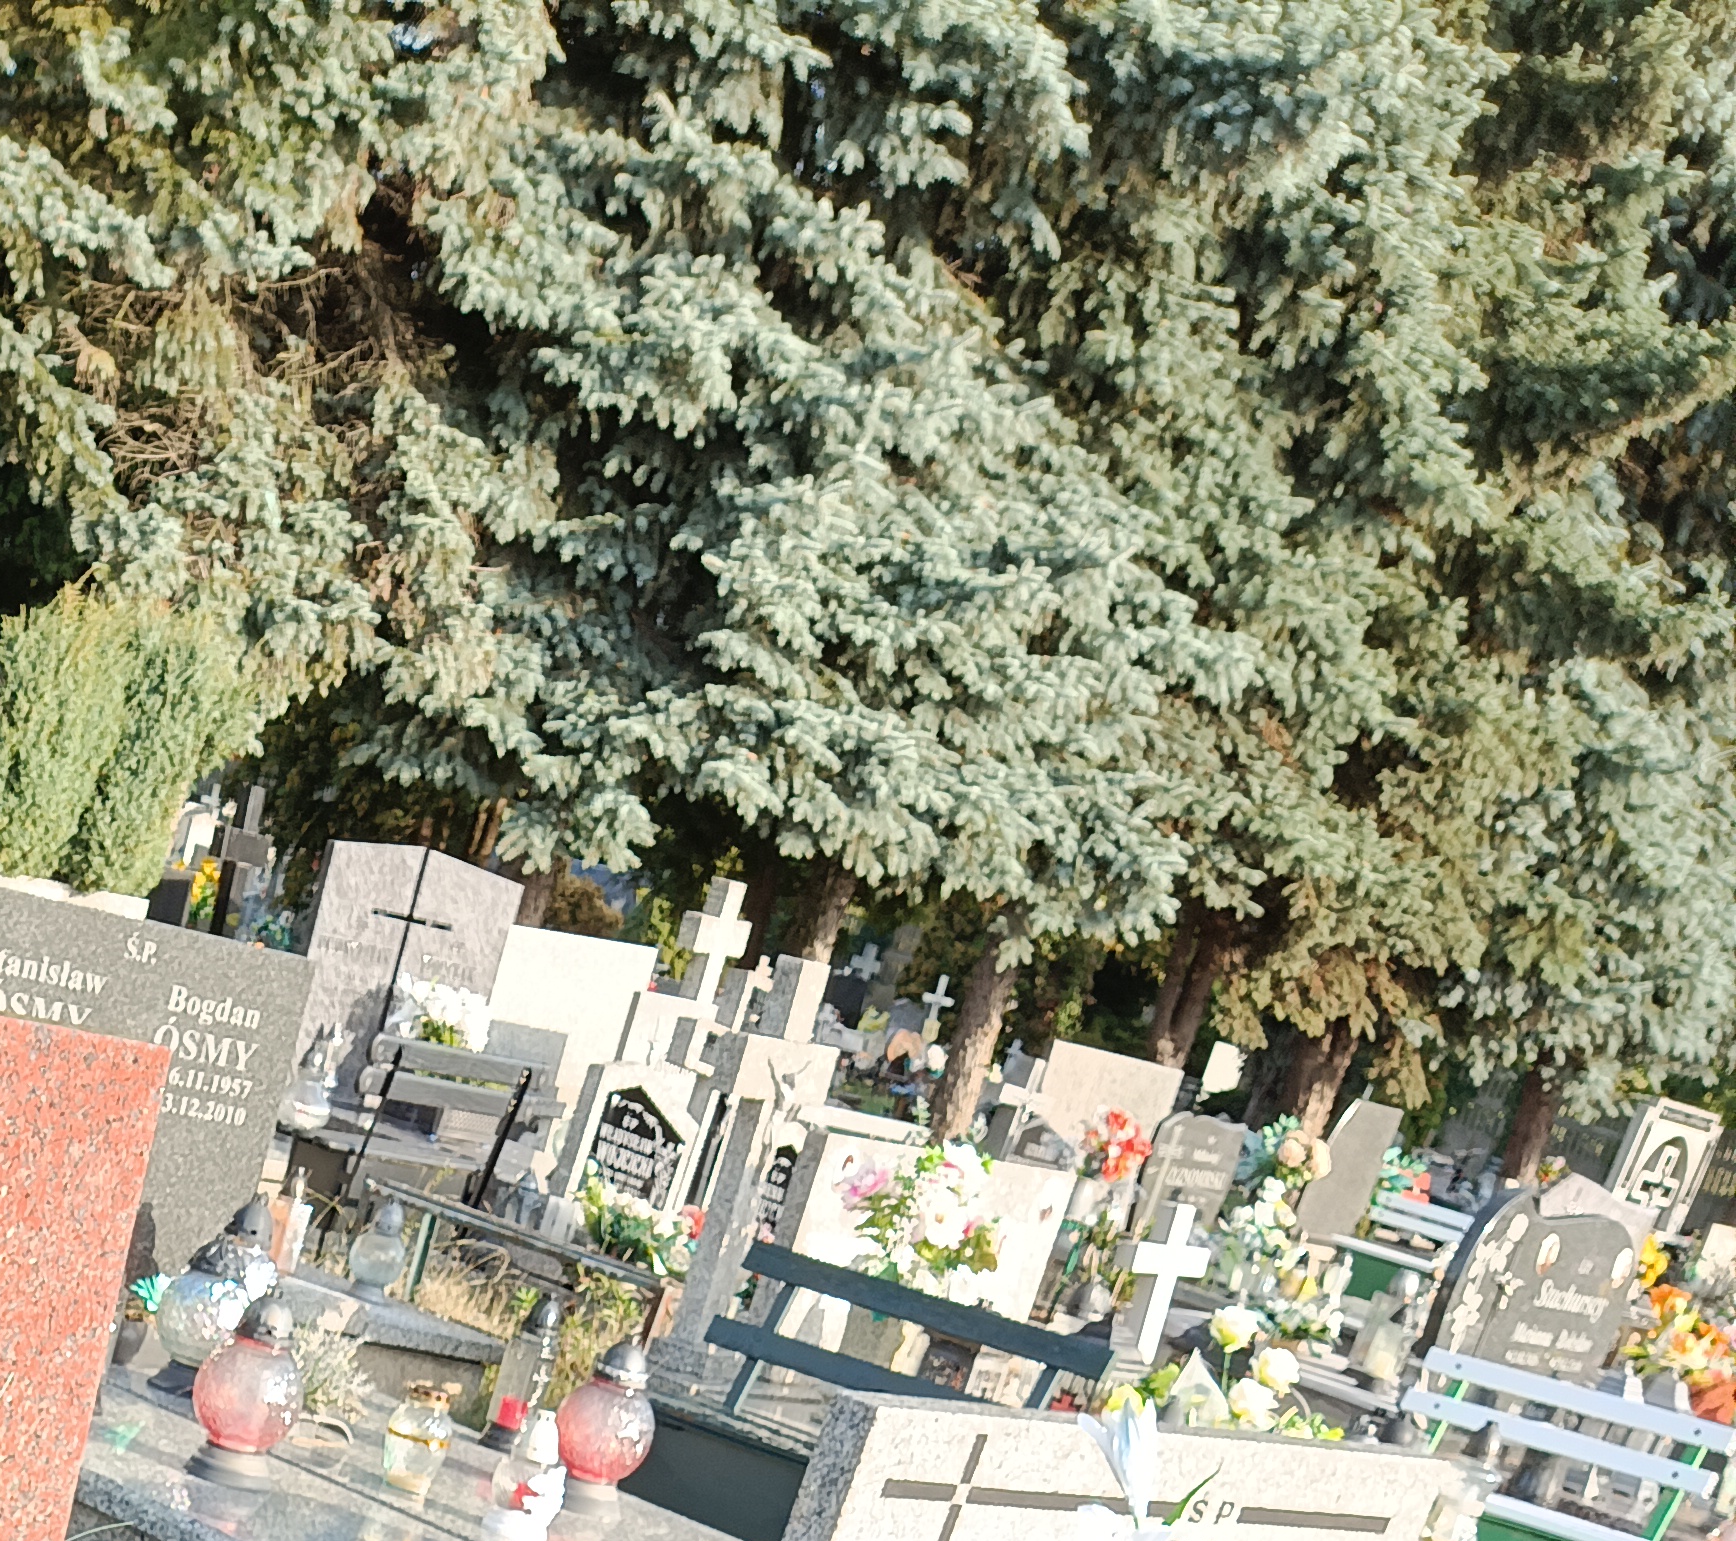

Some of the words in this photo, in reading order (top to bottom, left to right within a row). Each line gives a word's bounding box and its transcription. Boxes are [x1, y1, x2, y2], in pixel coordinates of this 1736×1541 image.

[168, 984, 262, 1030] Bogdan
[153, 1016, 260, 1071] ÓSMY
[159, 1088, 247, 1127] 3.12.2010
